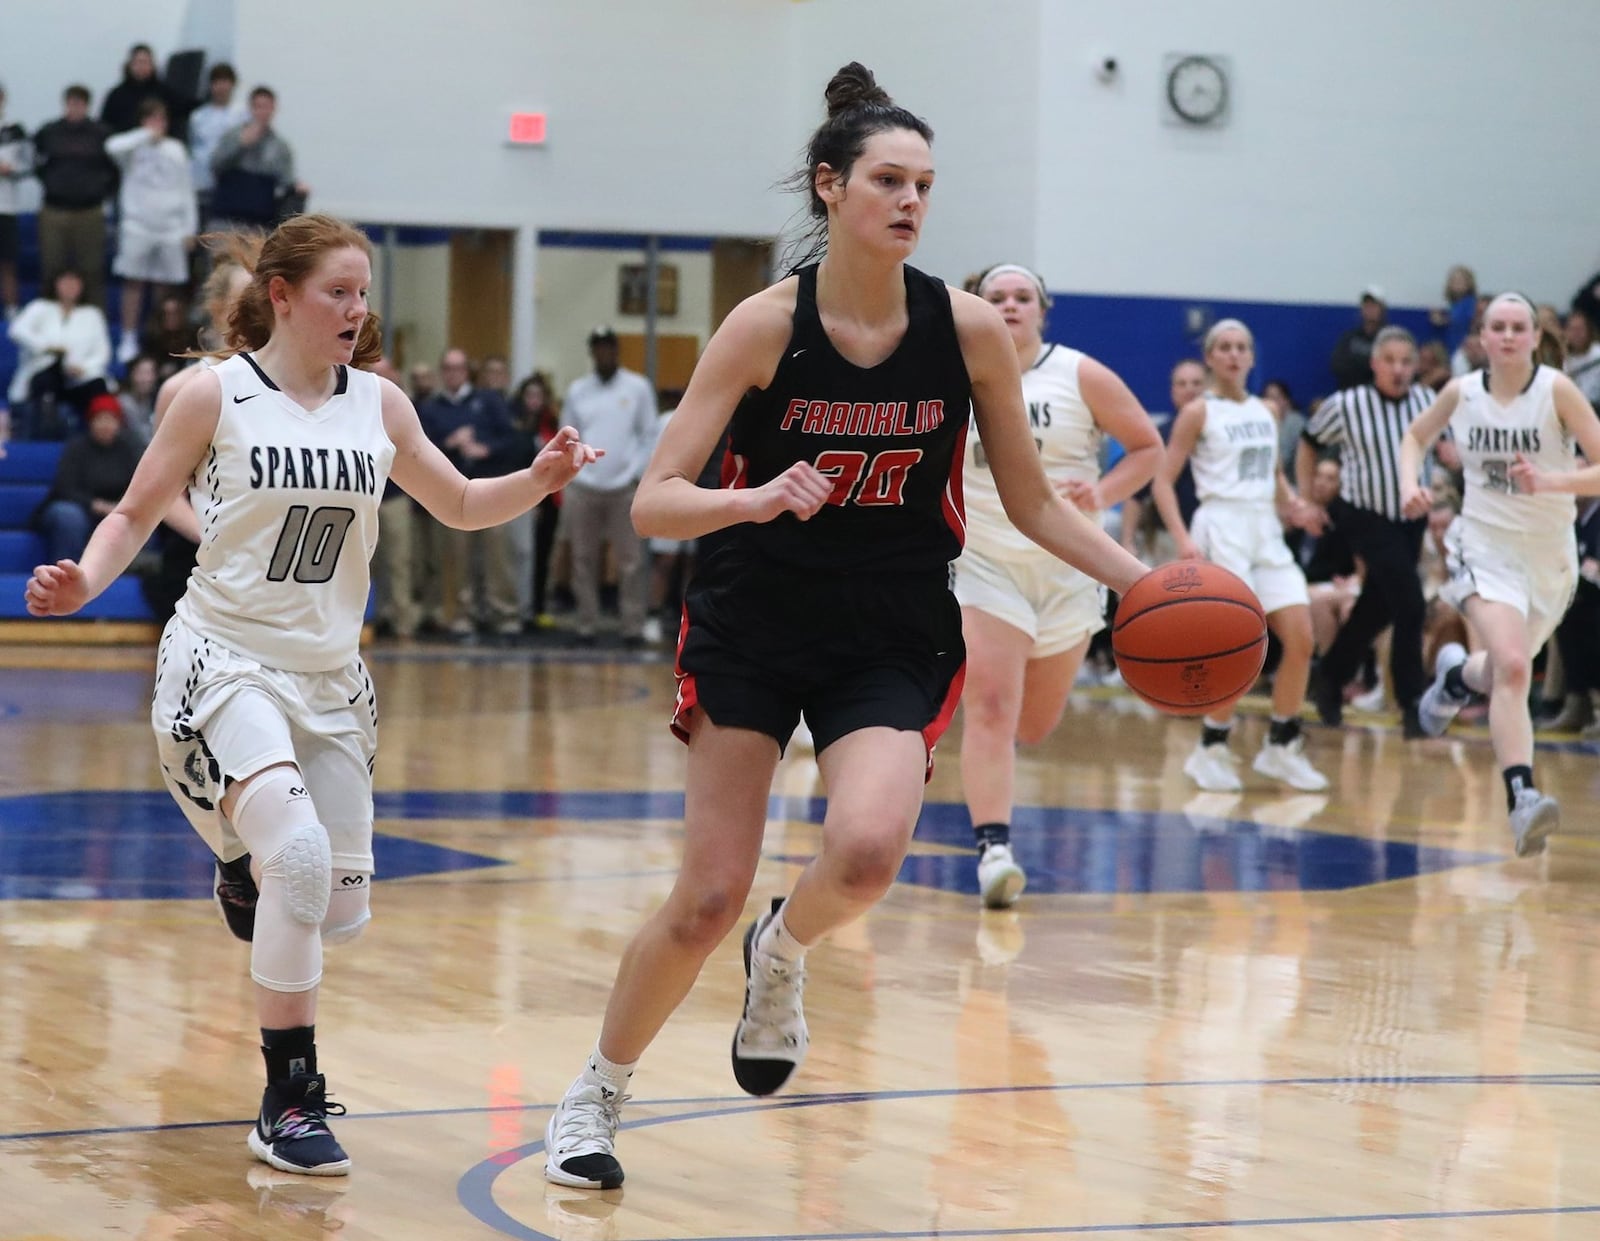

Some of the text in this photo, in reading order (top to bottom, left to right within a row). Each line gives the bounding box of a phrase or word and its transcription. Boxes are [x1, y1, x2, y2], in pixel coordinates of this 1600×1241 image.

[780, 399, 944, 436] FRANKLIN
[1468, 426, 1541, 453] SPARTANS
[250, 446, 376, 496] SPARTANS
[813, 448, 924, 507] 30
[266, 505, 356, 583] 10
